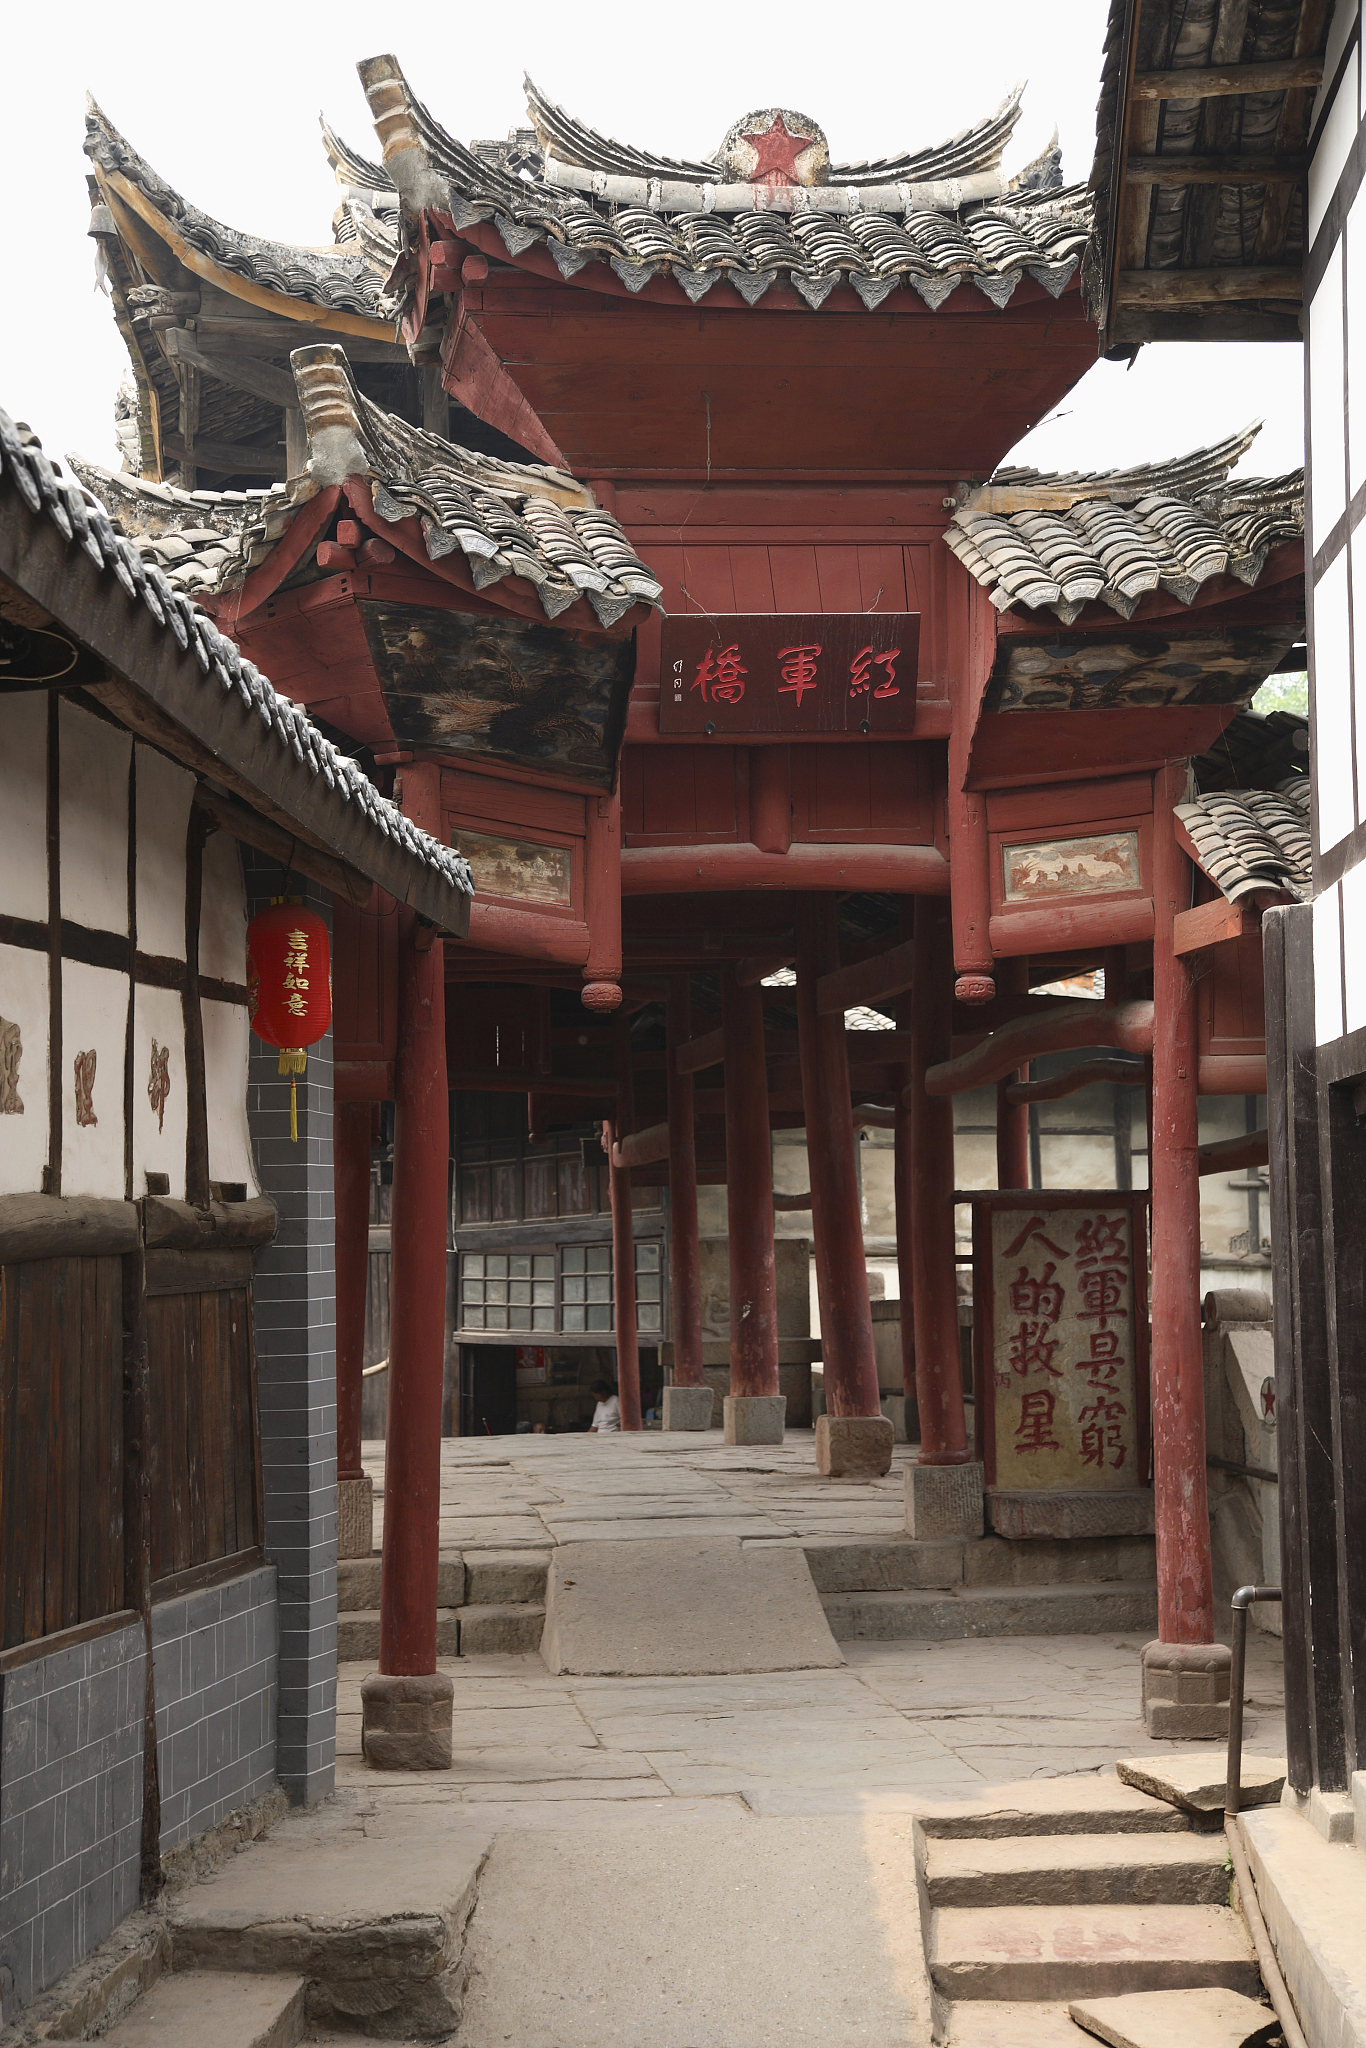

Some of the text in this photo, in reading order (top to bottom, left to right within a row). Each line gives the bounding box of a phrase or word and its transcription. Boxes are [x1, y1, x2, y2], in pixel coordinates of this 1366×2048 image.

[281, 928, 310, 1017] 吉祥如意
[1002, 1216, 1071, 1455] 人的救星
